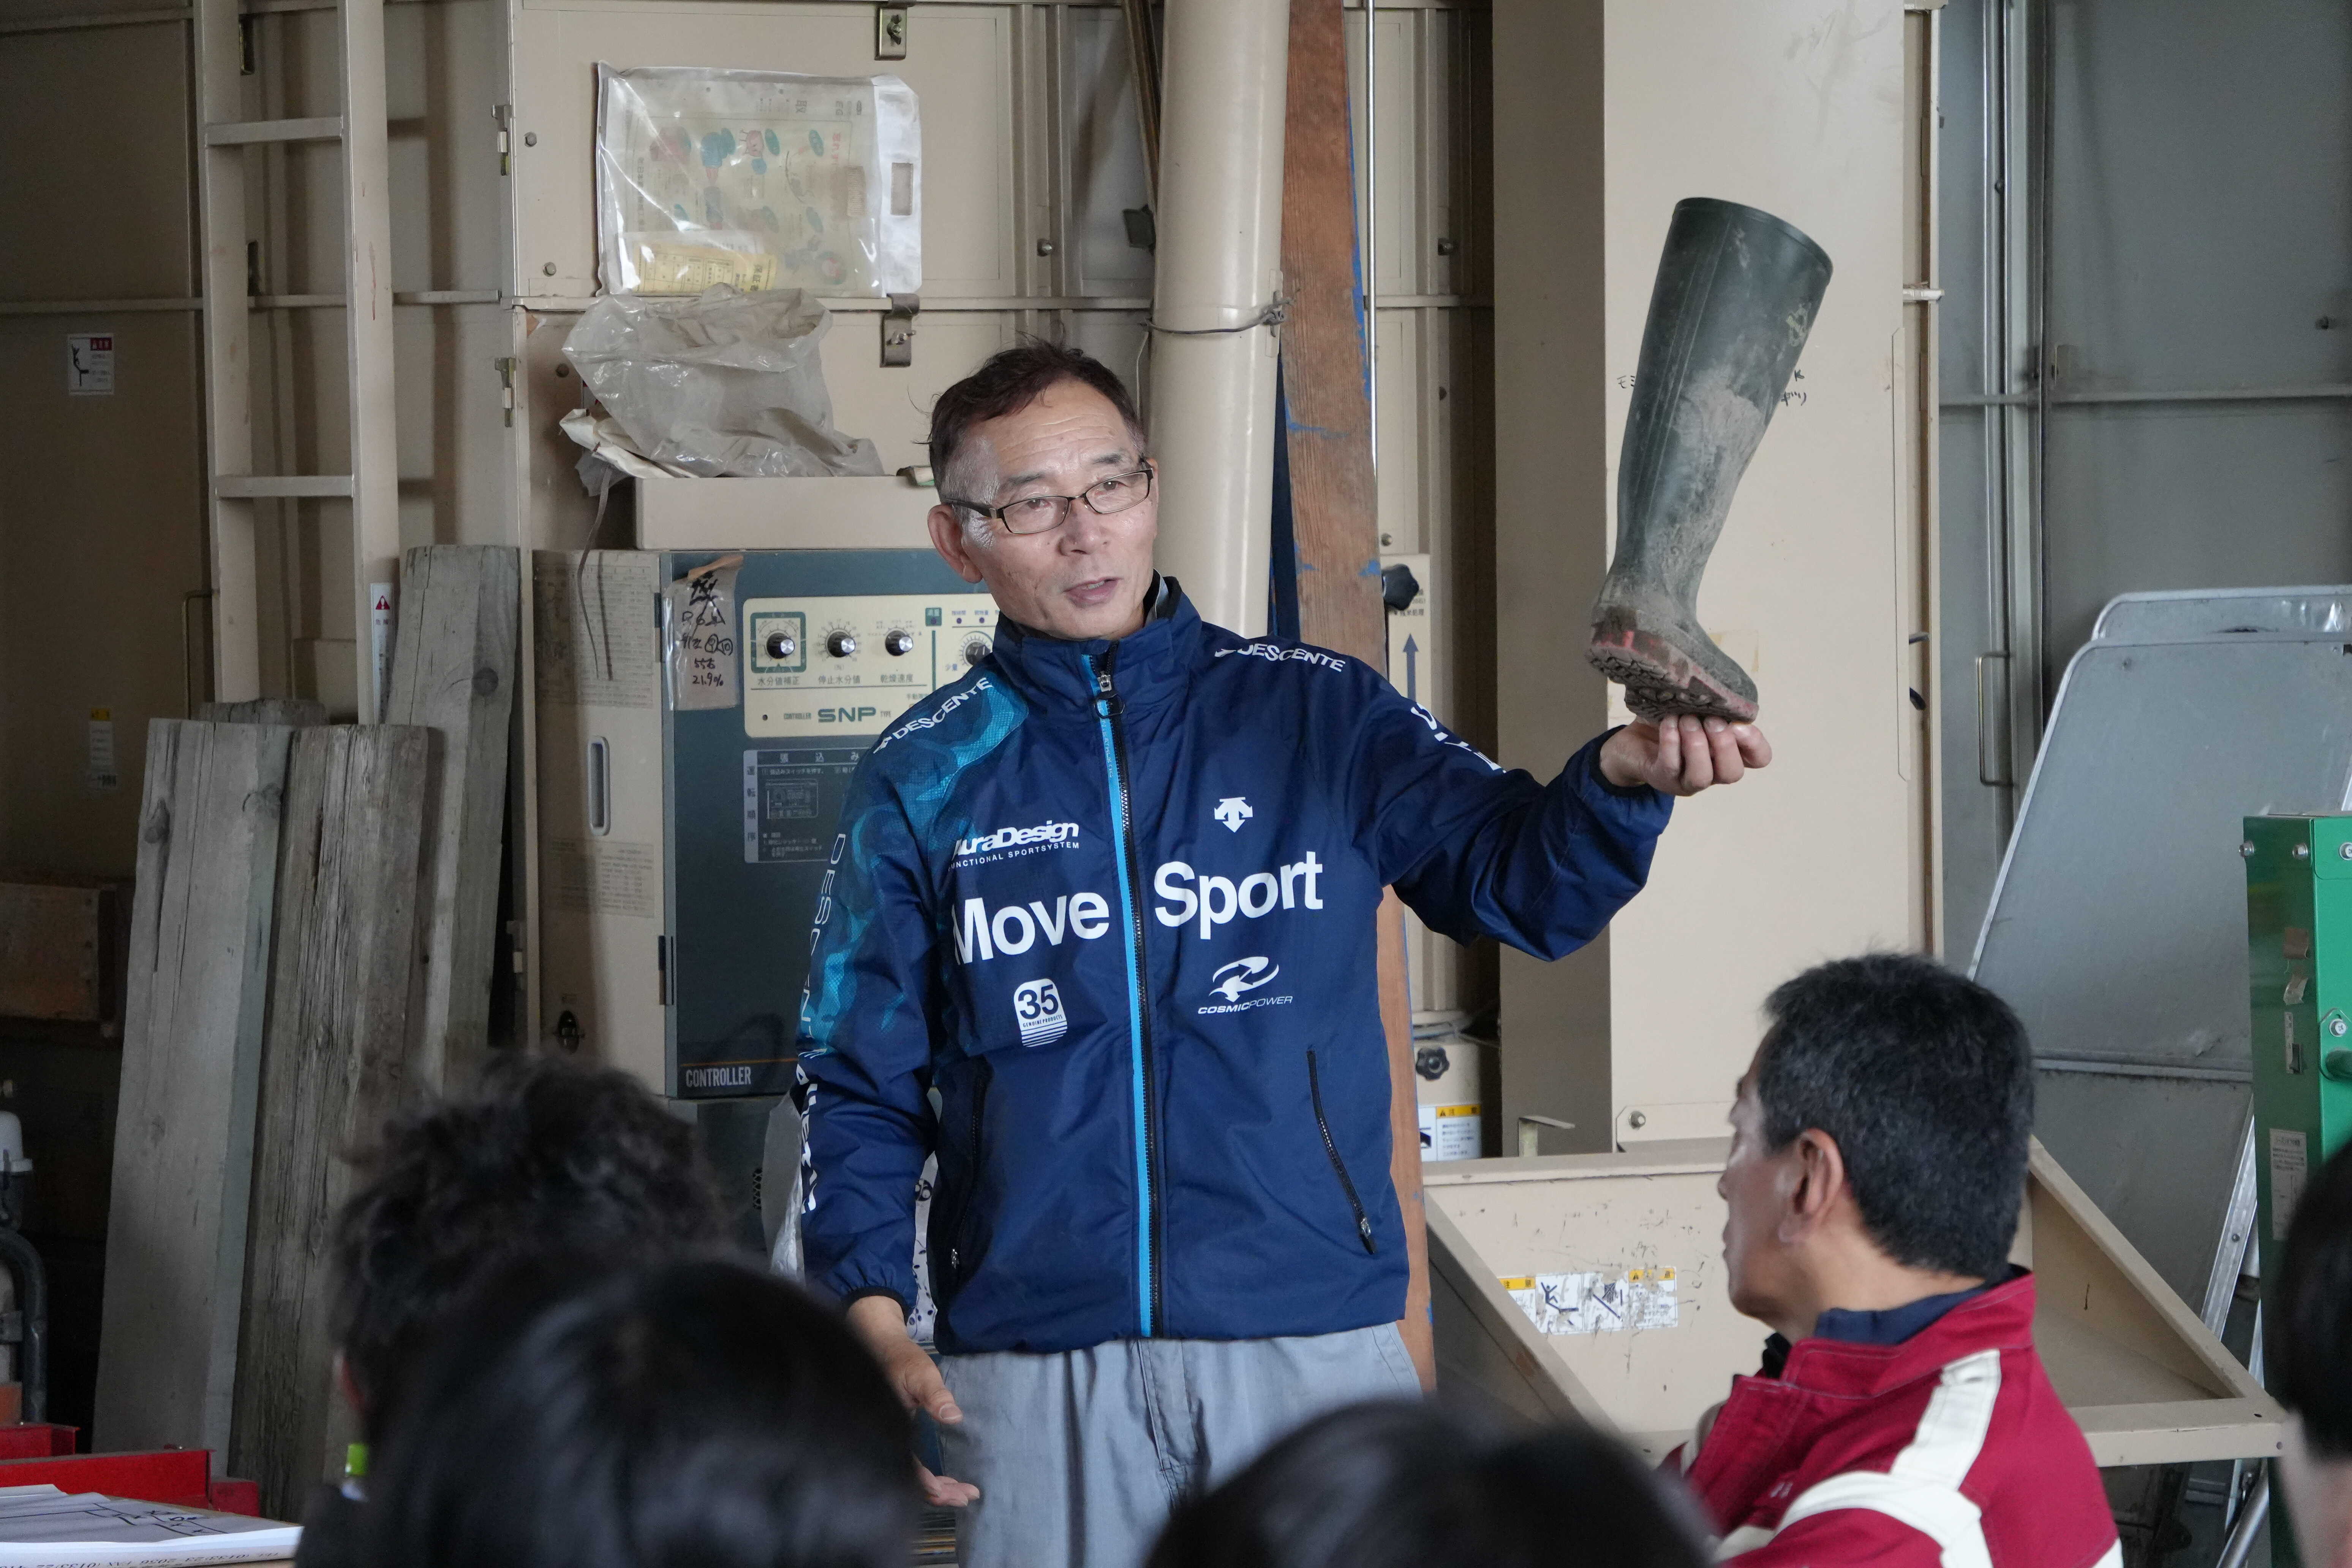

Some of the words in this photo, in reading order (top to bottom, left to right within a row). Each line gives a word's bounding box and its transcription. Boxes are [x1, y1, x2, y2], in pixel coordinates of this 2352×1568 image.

[817, 707, 877, 723] SNP
[892, 677, 994, 740] DESCENTE
[1008, 841, 1080, 858] SPORTSYSTEM
[952, 892, 1110, 965] Move
[1153, 850, 1323, 940] Sport
[1018, 984, 1059, 1020] 35
[1197, 996, 1293, 1014] COSMICPOWER
[1023, 1020, 1042, 1028] GENUINE
[1043, 1015, 1063, 1024] PRODUCTS
[686, 1066, 751, 1087] CONTROLLER
